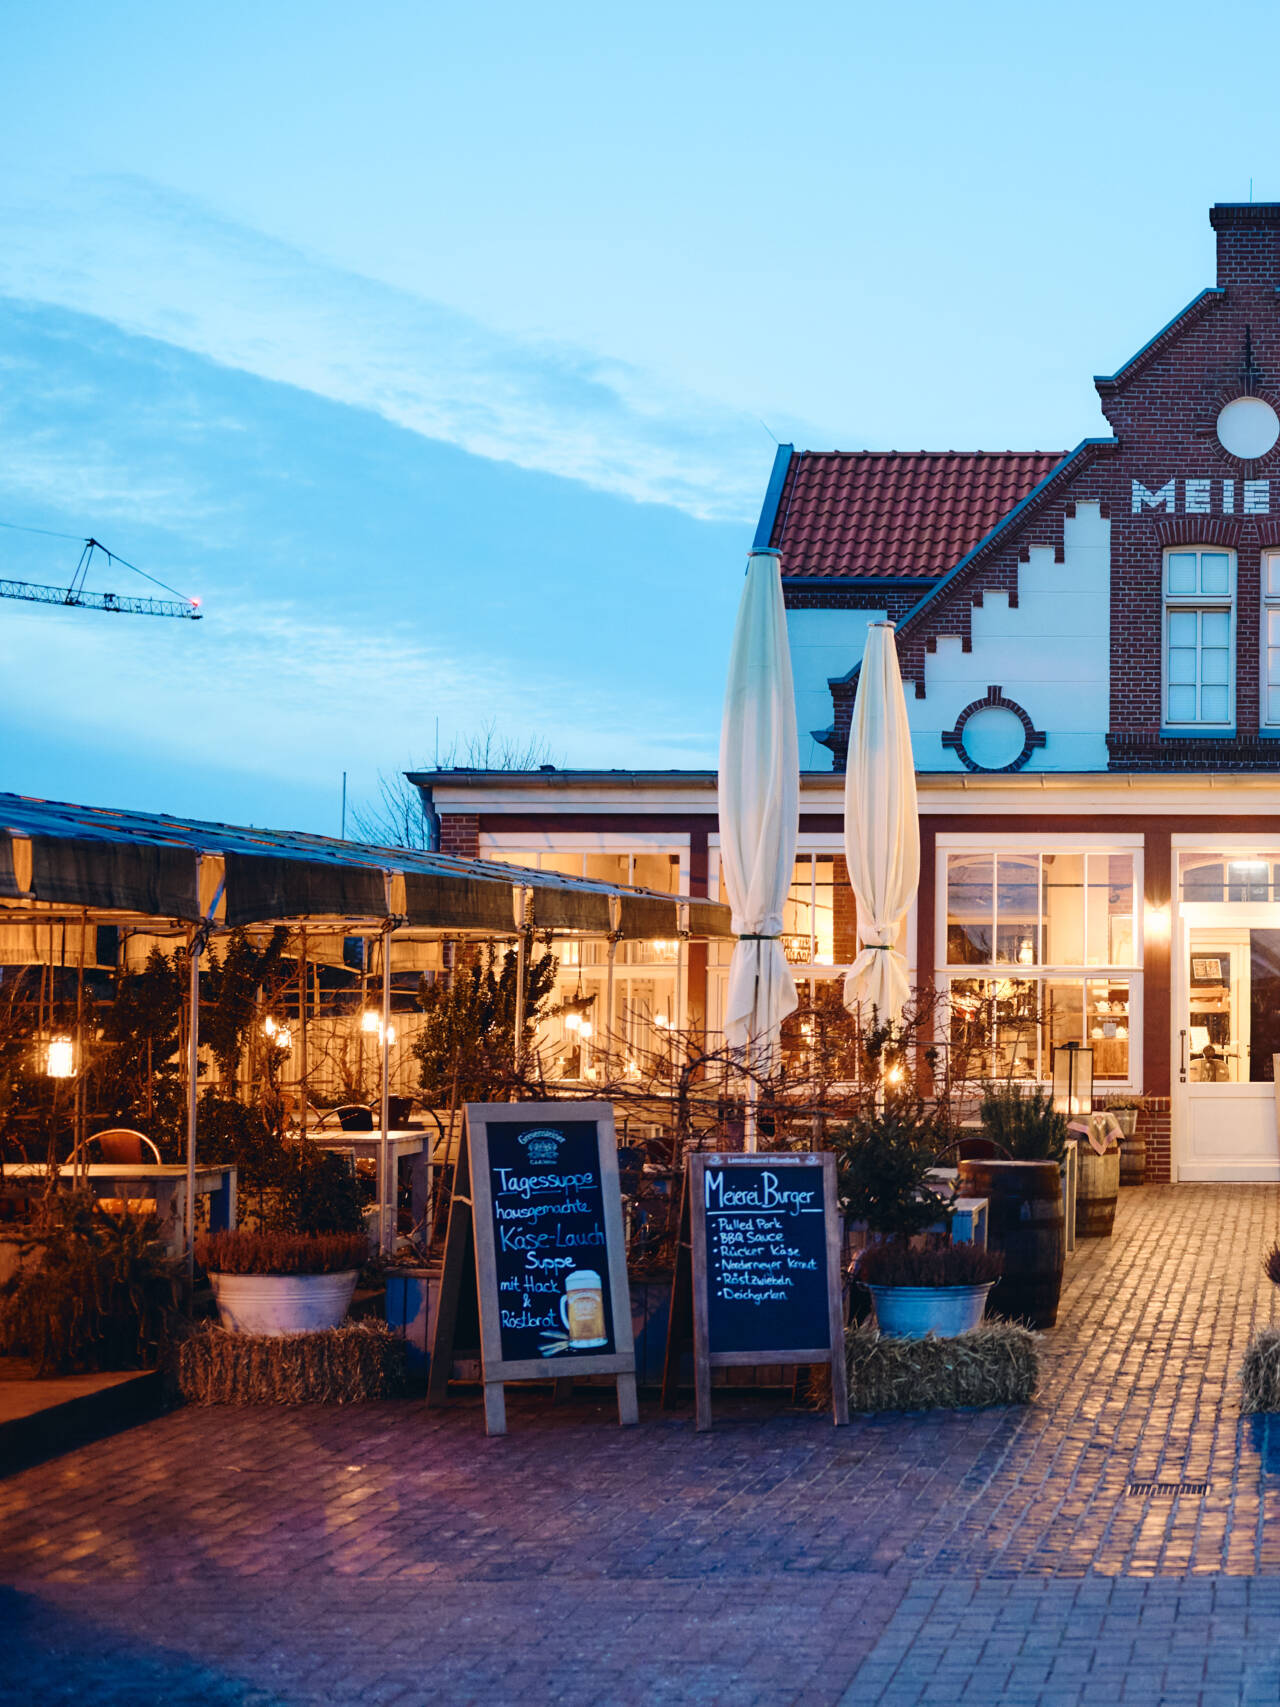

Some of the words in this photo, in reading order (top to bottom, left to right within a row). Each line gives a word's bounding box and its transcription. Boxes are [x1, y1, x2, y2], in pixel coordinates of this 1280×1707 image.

[493, 1168, 594, 1199] Tagessuppe
[705, 1170, 763, 1209] Meierei
[761, 1171, 815, 1216] Burger
[496, 1200, 592, 1225] hausgemachte
[718, 1217, 754, 1231] Pulled
[756, 1217, 783, 1230] Pork
[500, 1223, 605, 1252] Käse-Lauch
[720, 1232, 744, 1244] BBQ
[746, 1231, 784, 1243] Sauce
[770, 1244, 800, 1257] Käse
[524, 1251, 576, 1276] Suppe
[500, 1275, 521, 1291] mit
[523, 1276, 561, 1294] Hack
[523, 1294, 532, 1308] &
[501, 1309, 560, 1329] Röstbrot
